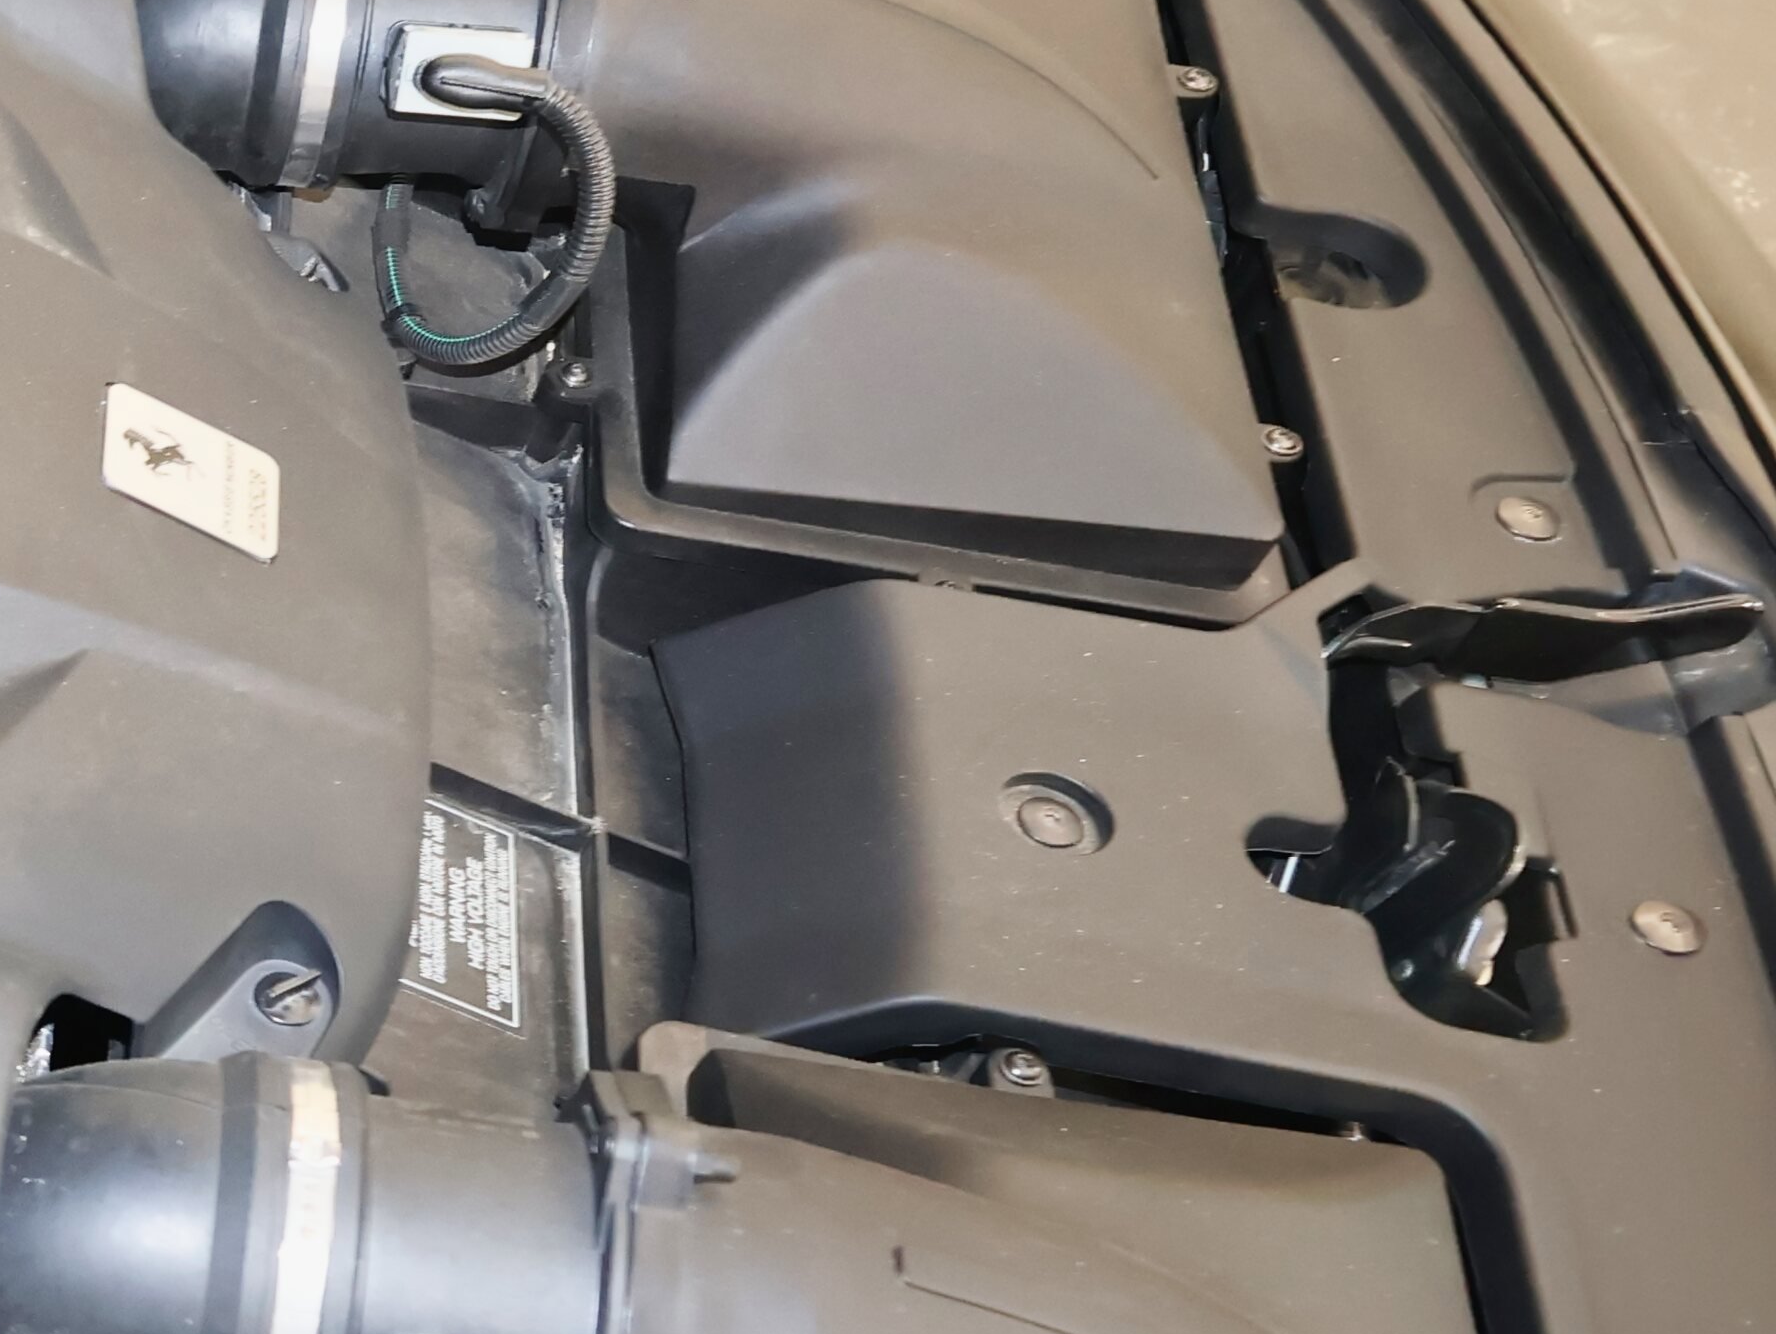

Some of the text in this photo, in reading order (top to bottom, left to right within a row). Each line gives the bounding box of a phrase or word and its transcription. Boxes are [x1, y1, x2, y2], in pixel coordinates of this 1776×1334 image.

[448, 867, 466, 943] WARNING
[466, 857, 484, 969] HIGH VOLTAGE
[486, 973, 500, 995] NOT
[486, 995, 501, 1010] DO
